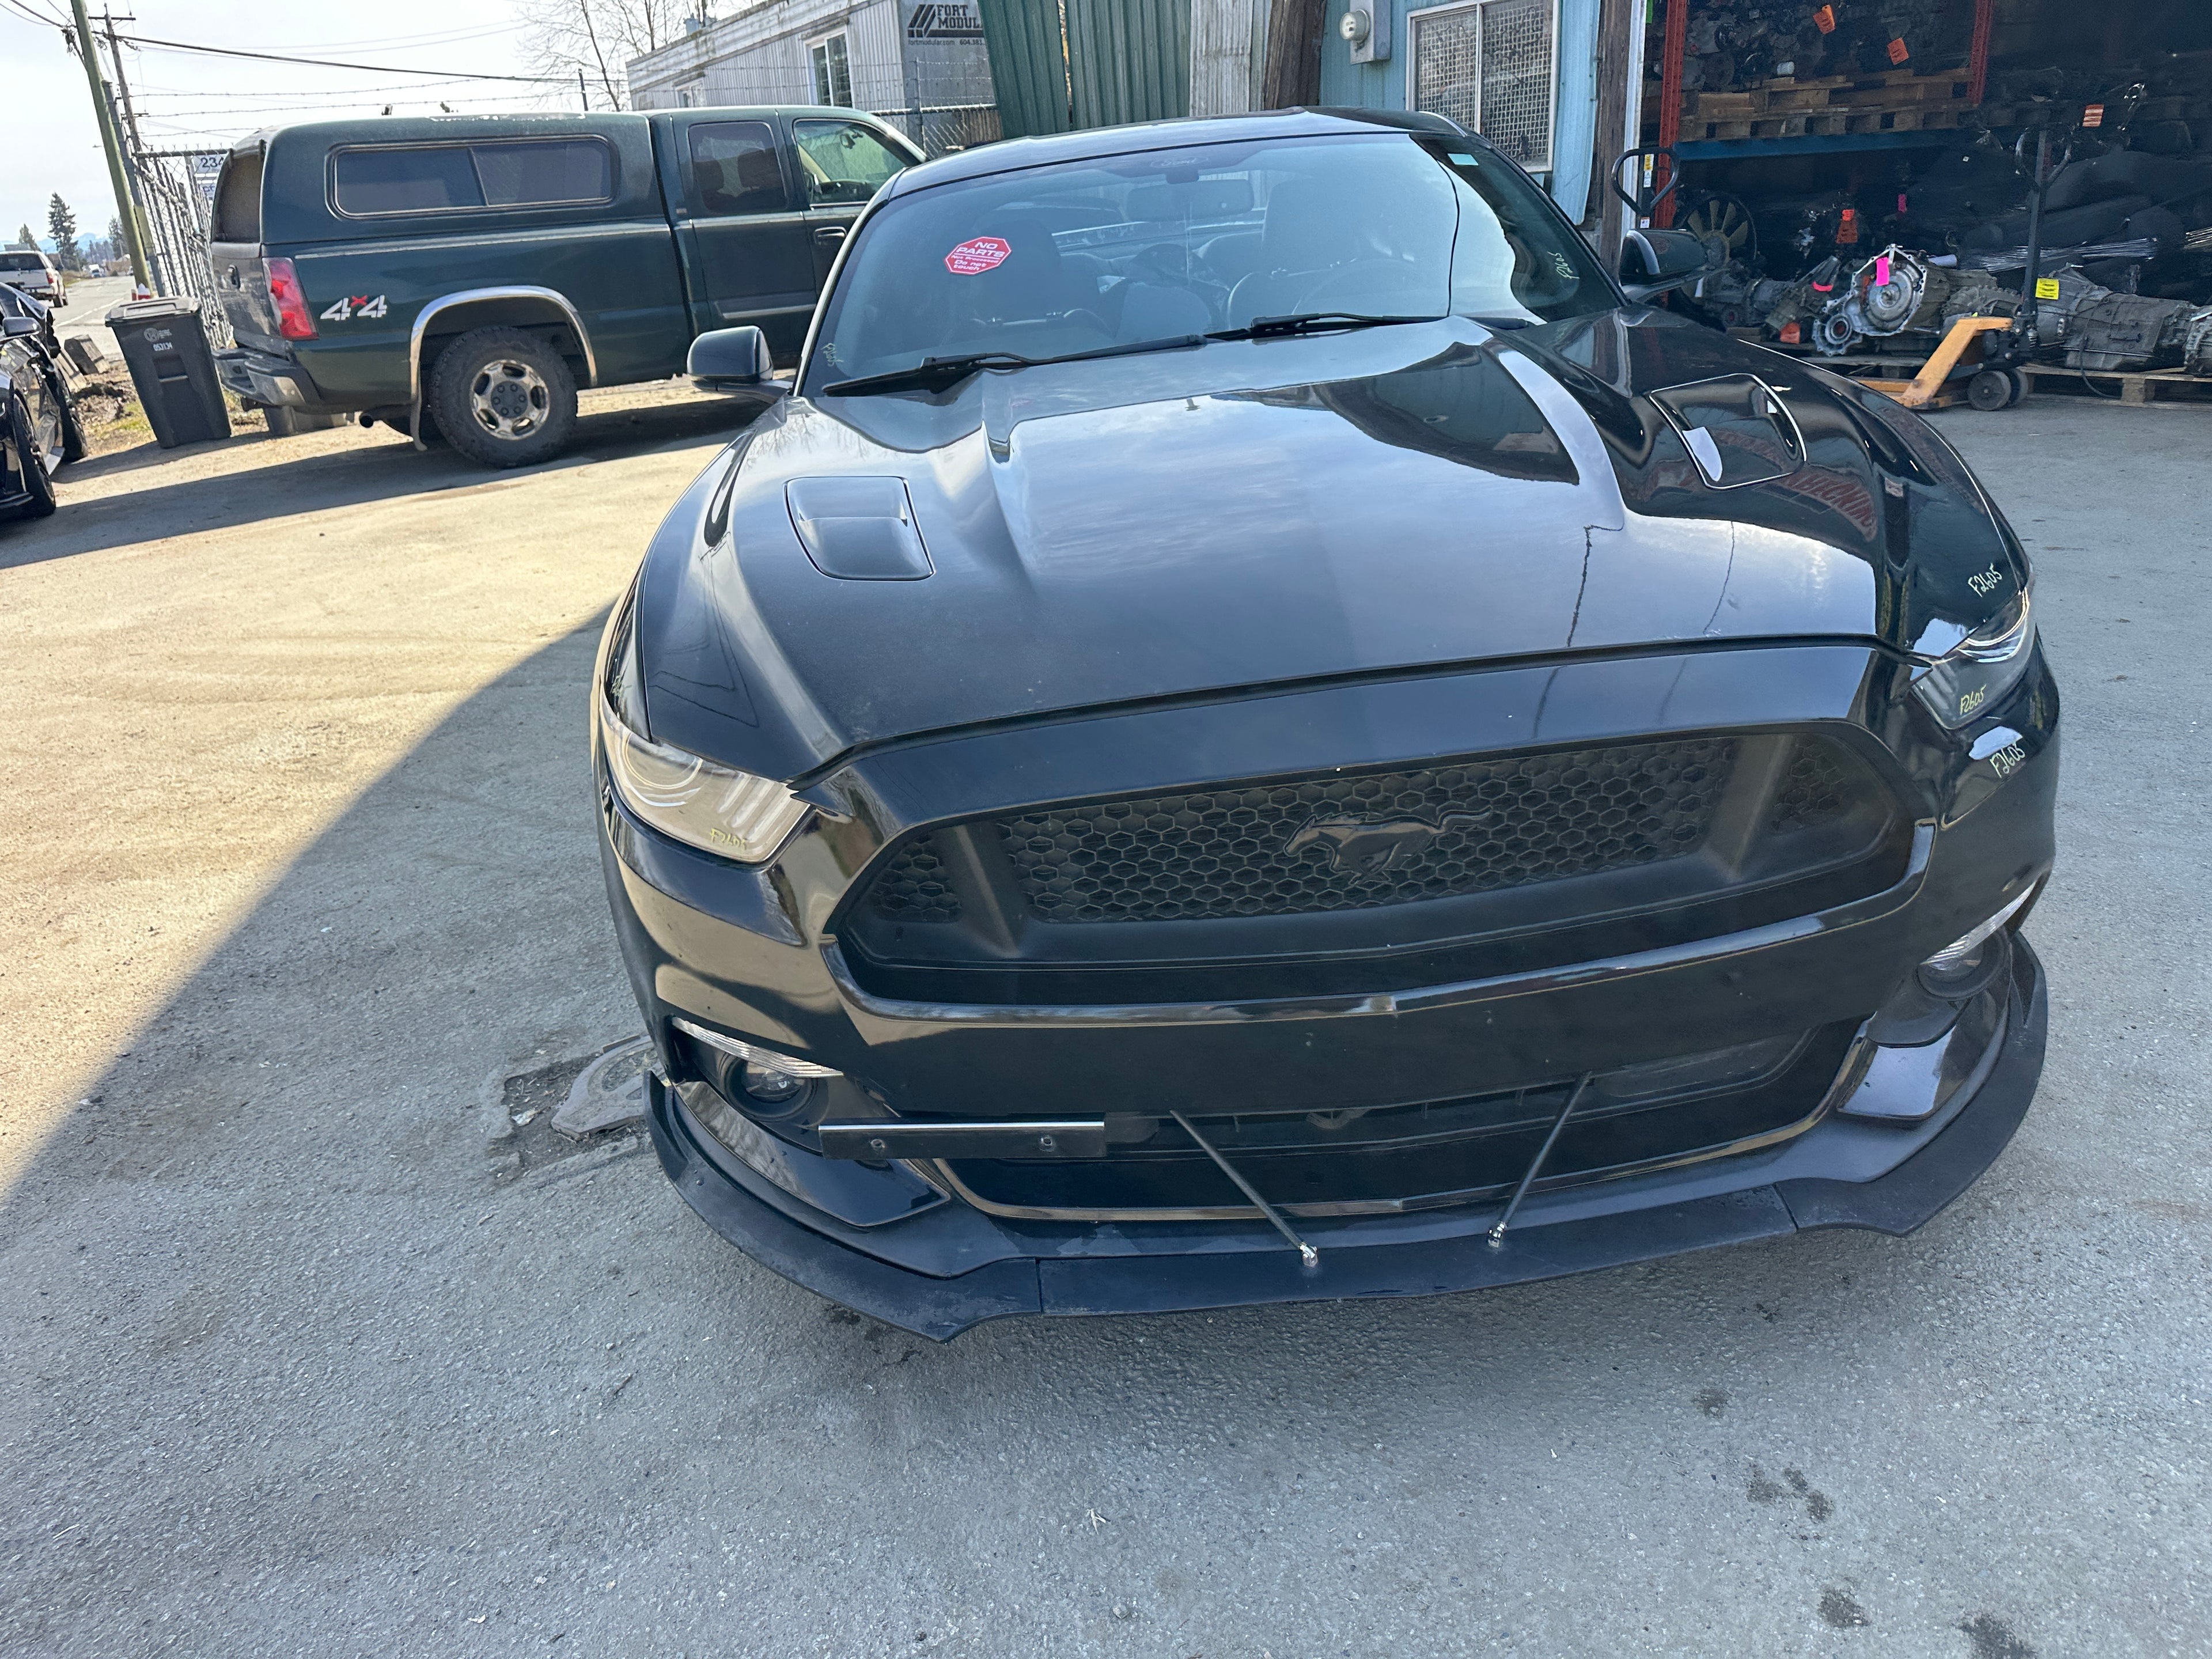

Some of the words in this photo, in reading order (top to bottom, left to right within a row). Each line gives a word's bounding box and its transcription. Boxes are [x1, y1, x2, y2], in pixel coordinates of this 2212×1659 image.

[937, 5, 968, 16] FORT
[938, 17, 983, 28] MODUL
[956, 247, 1005, 257] PARTS
[1968, 562, 2002, 597] F2605
[1960, 683, 1987, 715] F2605
